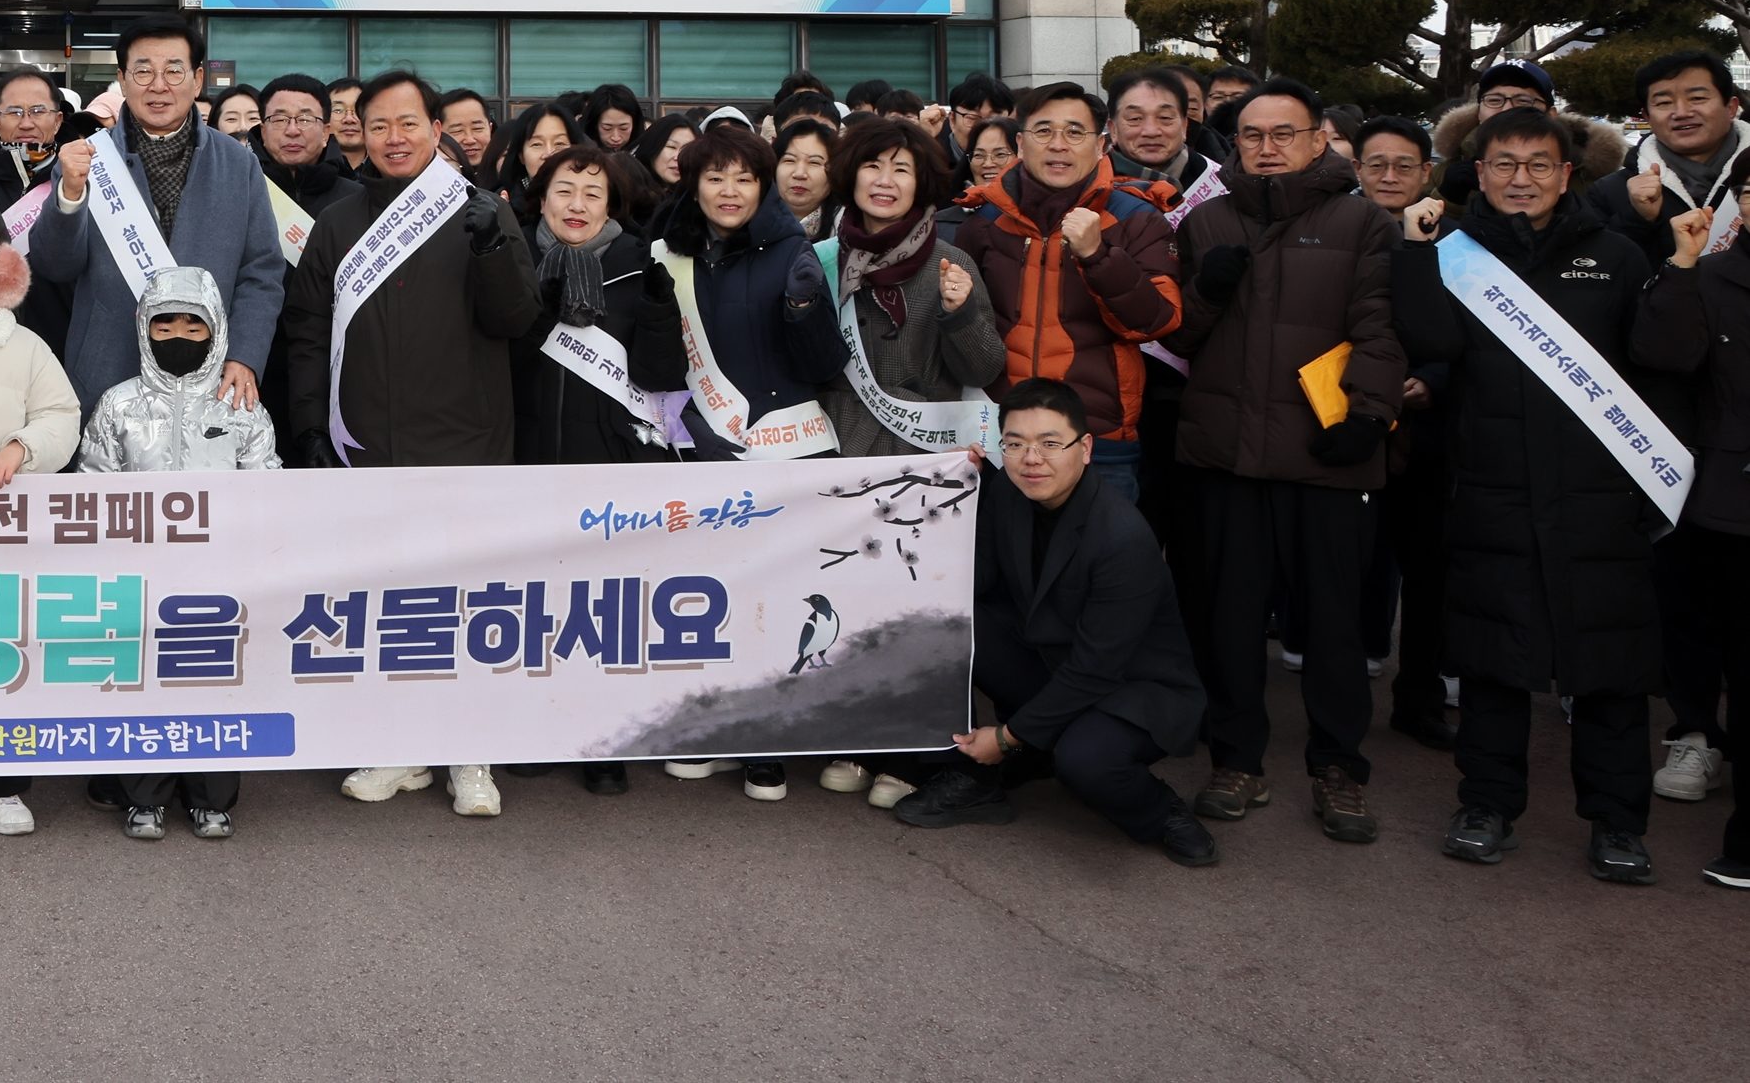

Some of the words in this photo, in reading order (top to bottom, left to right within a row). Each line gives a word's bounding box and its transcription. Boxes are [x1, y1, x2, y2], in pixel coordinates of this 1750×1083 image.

[366, 188, 427, 253] 물가안정에
[352, 244, 400, 297] 이용하여
[556, 331, 599, 364] 공정한
[599, 358, 625, 382] 가격
[842, 325, 869, 380] 착한가격
[869, 384, 922, 424] 착한업소
[698, 374, 733, 411] 절약,
[1483, 284, 1613, 403] 착한가격업소에서,
[1603, 404, 1652, 455] 행복한
[1651, 455, 1683, 489] 소비
[860, 384, 908, 433] 살맛나는
[910, 428, 957, 445] 지역경제
[48, 491, 211, 545] 캠페인
[580, 500, 694, 540] 어머니품
[697, 490, 785, 530] 장흥
[283, 574, 734, 685] 선물하세요
[106, 719, 252, 756] 가능합니다
